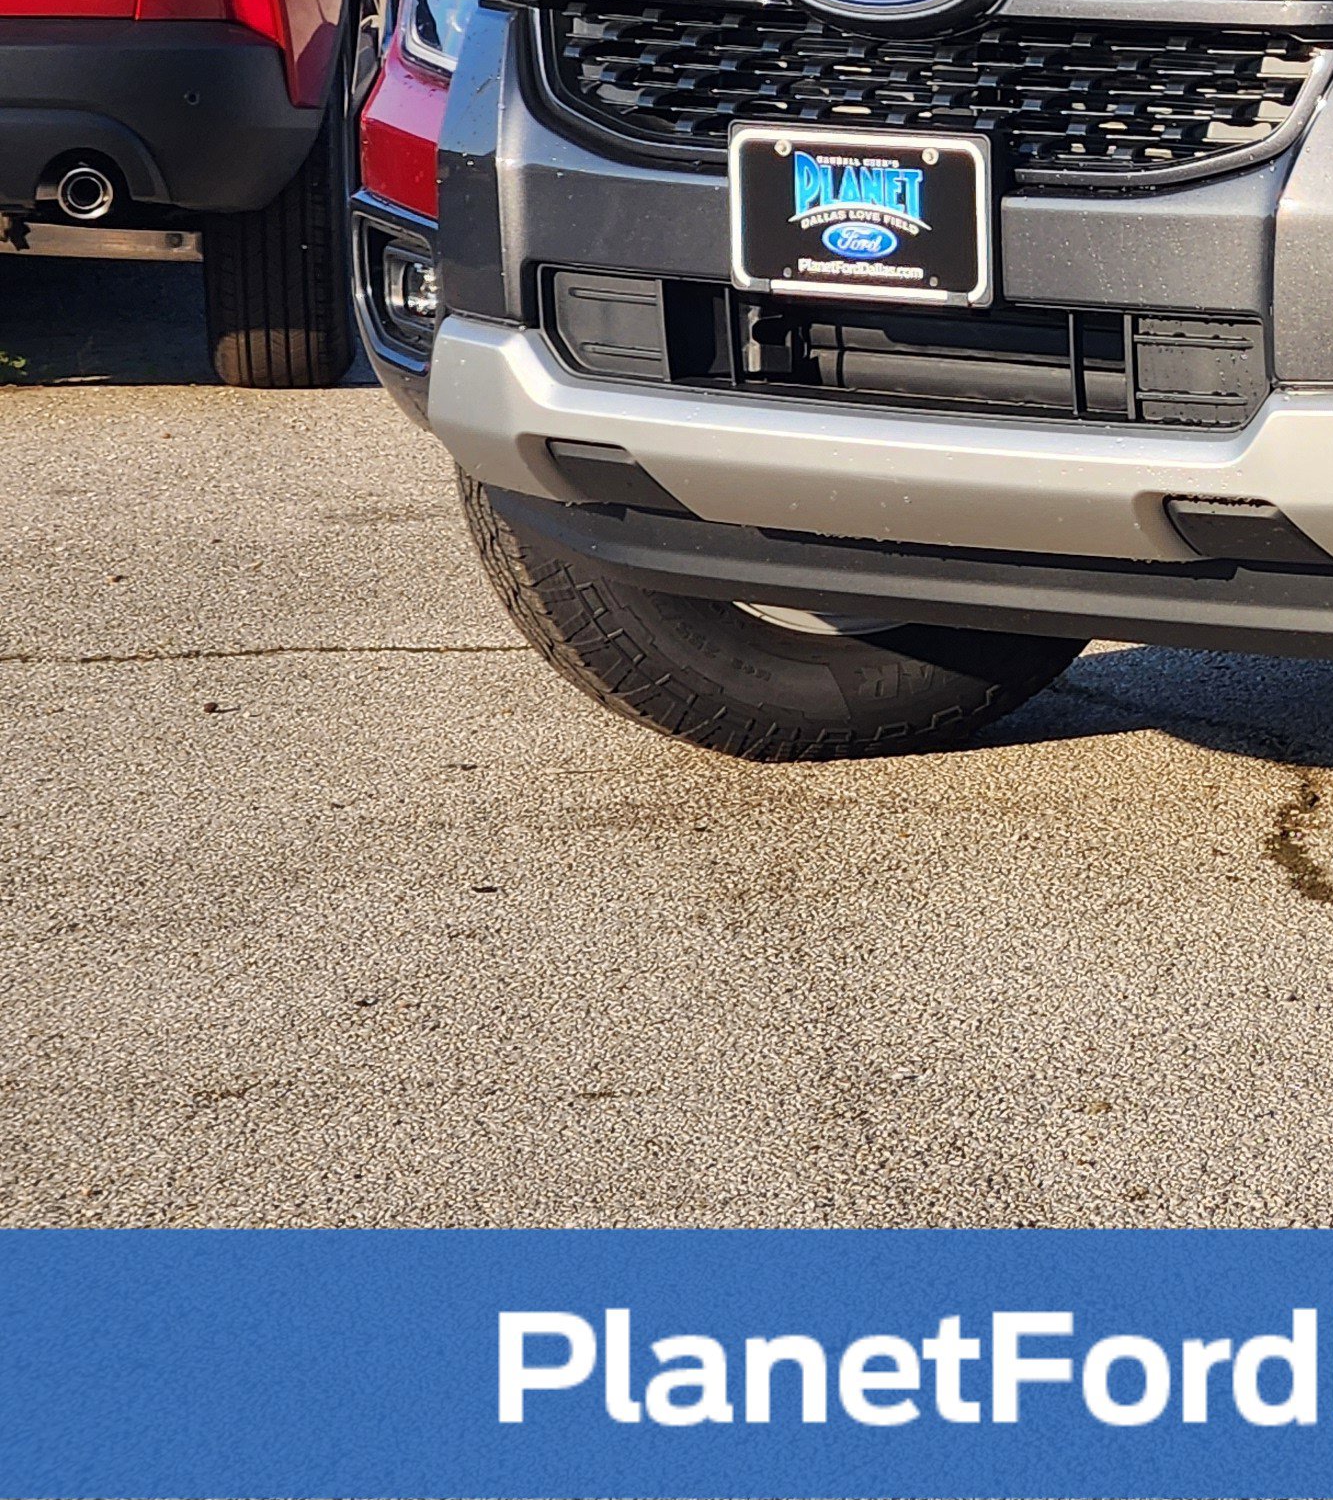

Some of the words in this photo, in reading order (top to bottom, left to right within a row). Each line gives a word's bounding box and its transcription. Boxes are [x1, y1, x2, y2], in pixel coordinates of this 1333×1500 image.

[794, 151, 923, 221] PLANET
[801, 210, 847, 230] DALLAS
[848, 209, 881, 222] LOVE
[883, 214, 919, 237] FIELD
[837, 227, 882, 251] Ford
